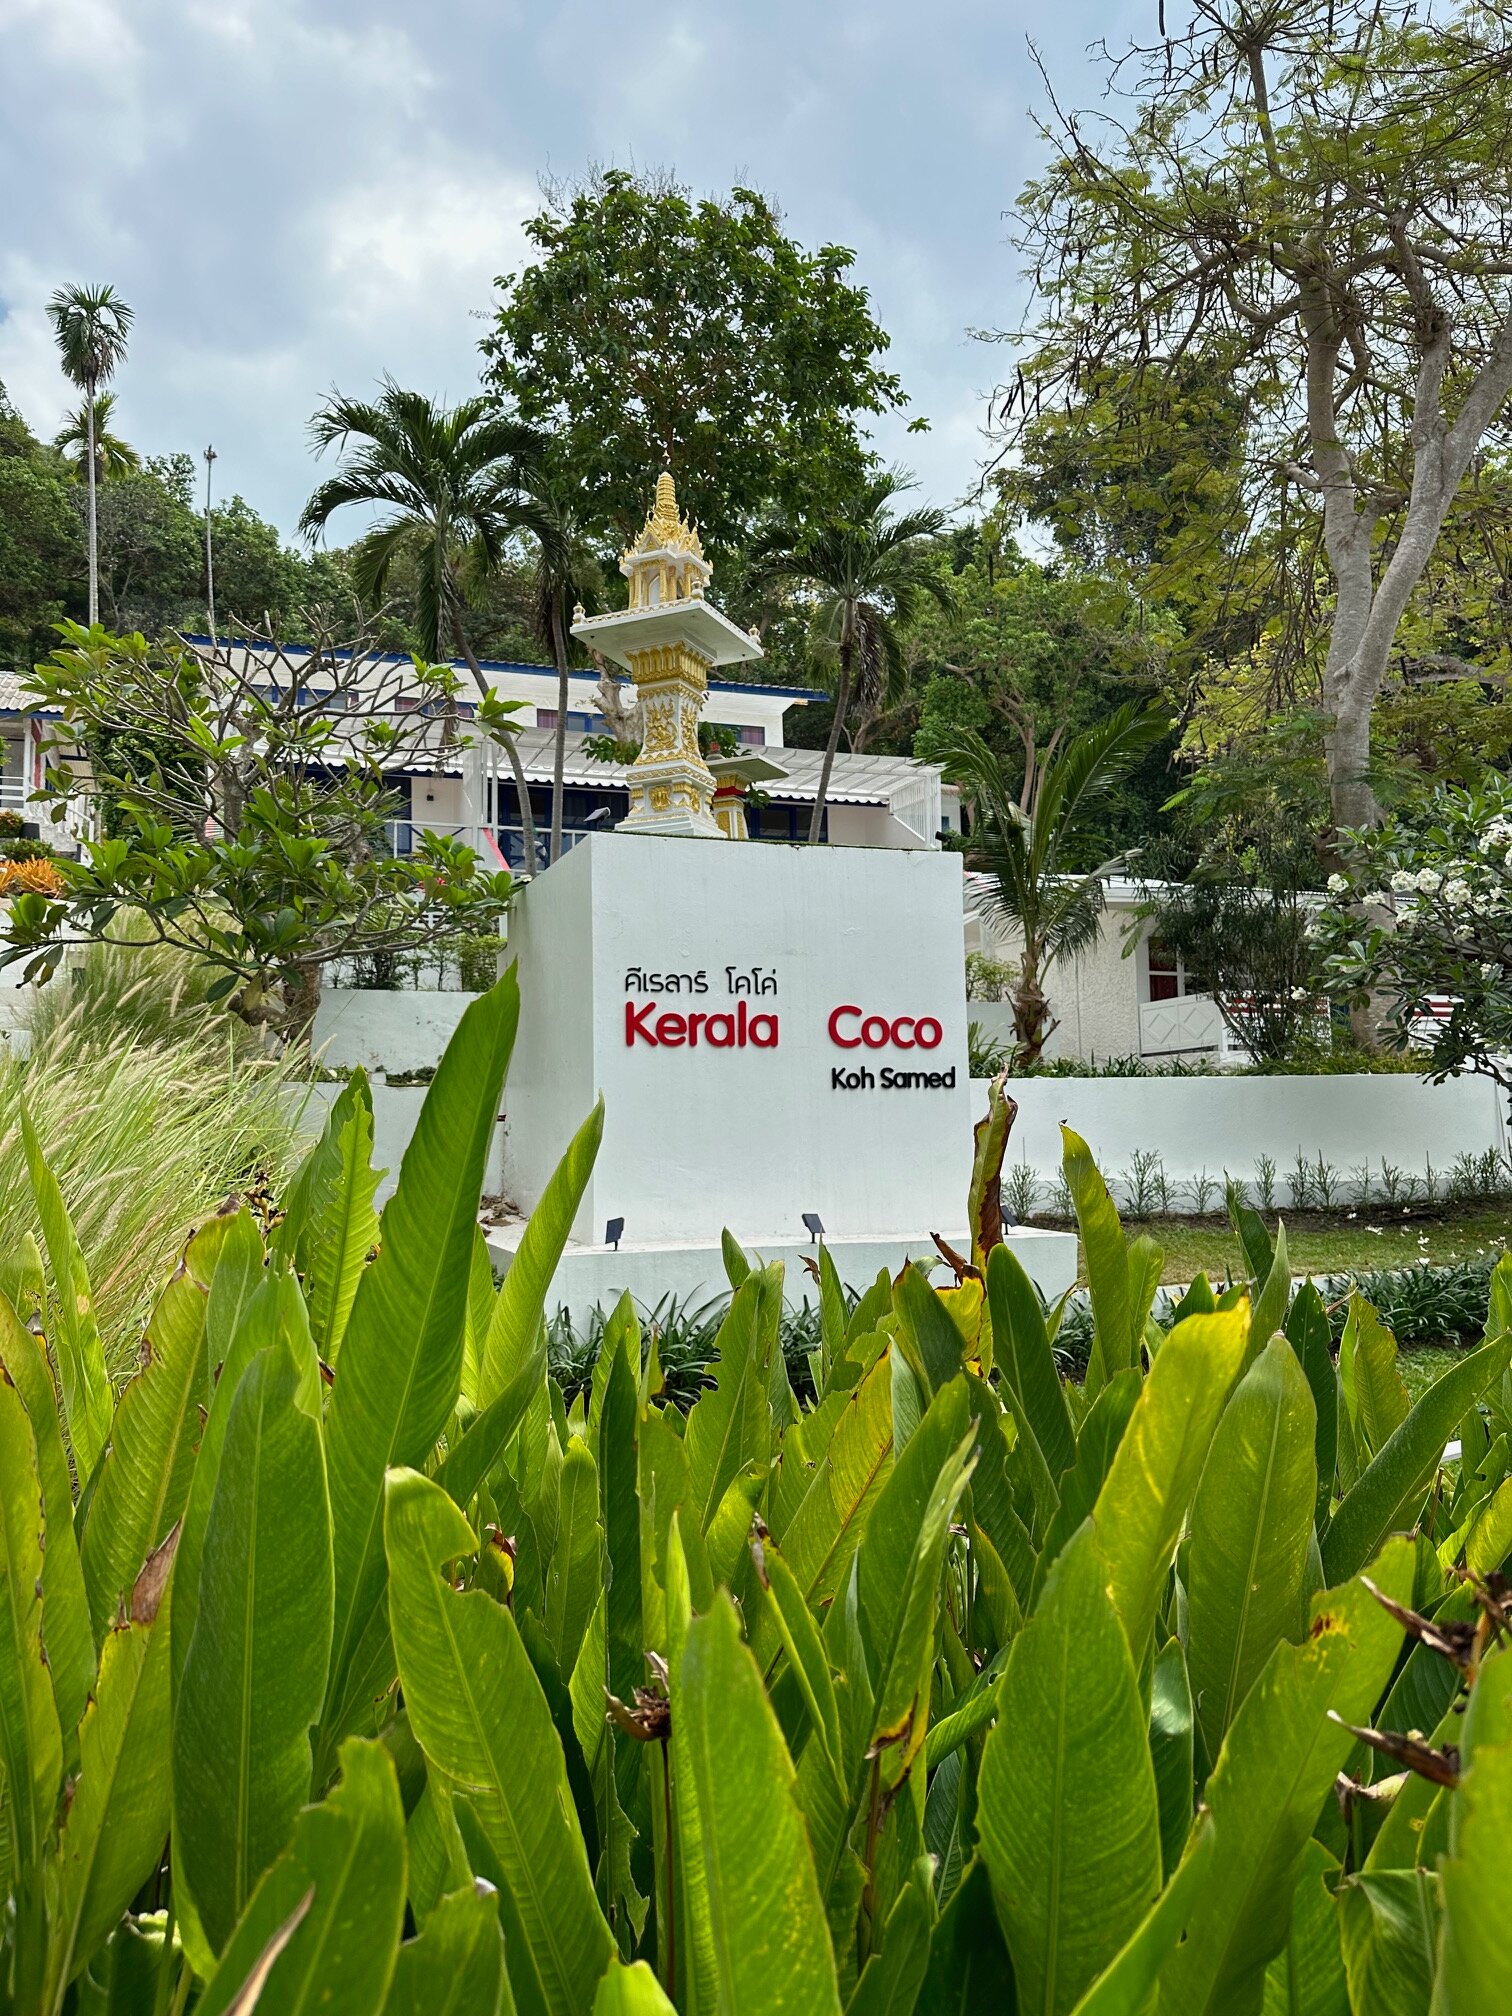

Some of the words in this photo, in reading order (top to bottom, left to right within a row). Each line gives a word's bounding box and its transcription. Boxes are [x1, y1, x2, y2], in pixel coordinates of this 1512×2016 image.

[724, 965, 778, 996] โคโค่
[625, 1001, 779, 1048] Kerala
[828, 1005, 943, 1050] Coco
[831, 1065, 876, 1090] Koh
[879, 1065, 956, 1090] Samed
